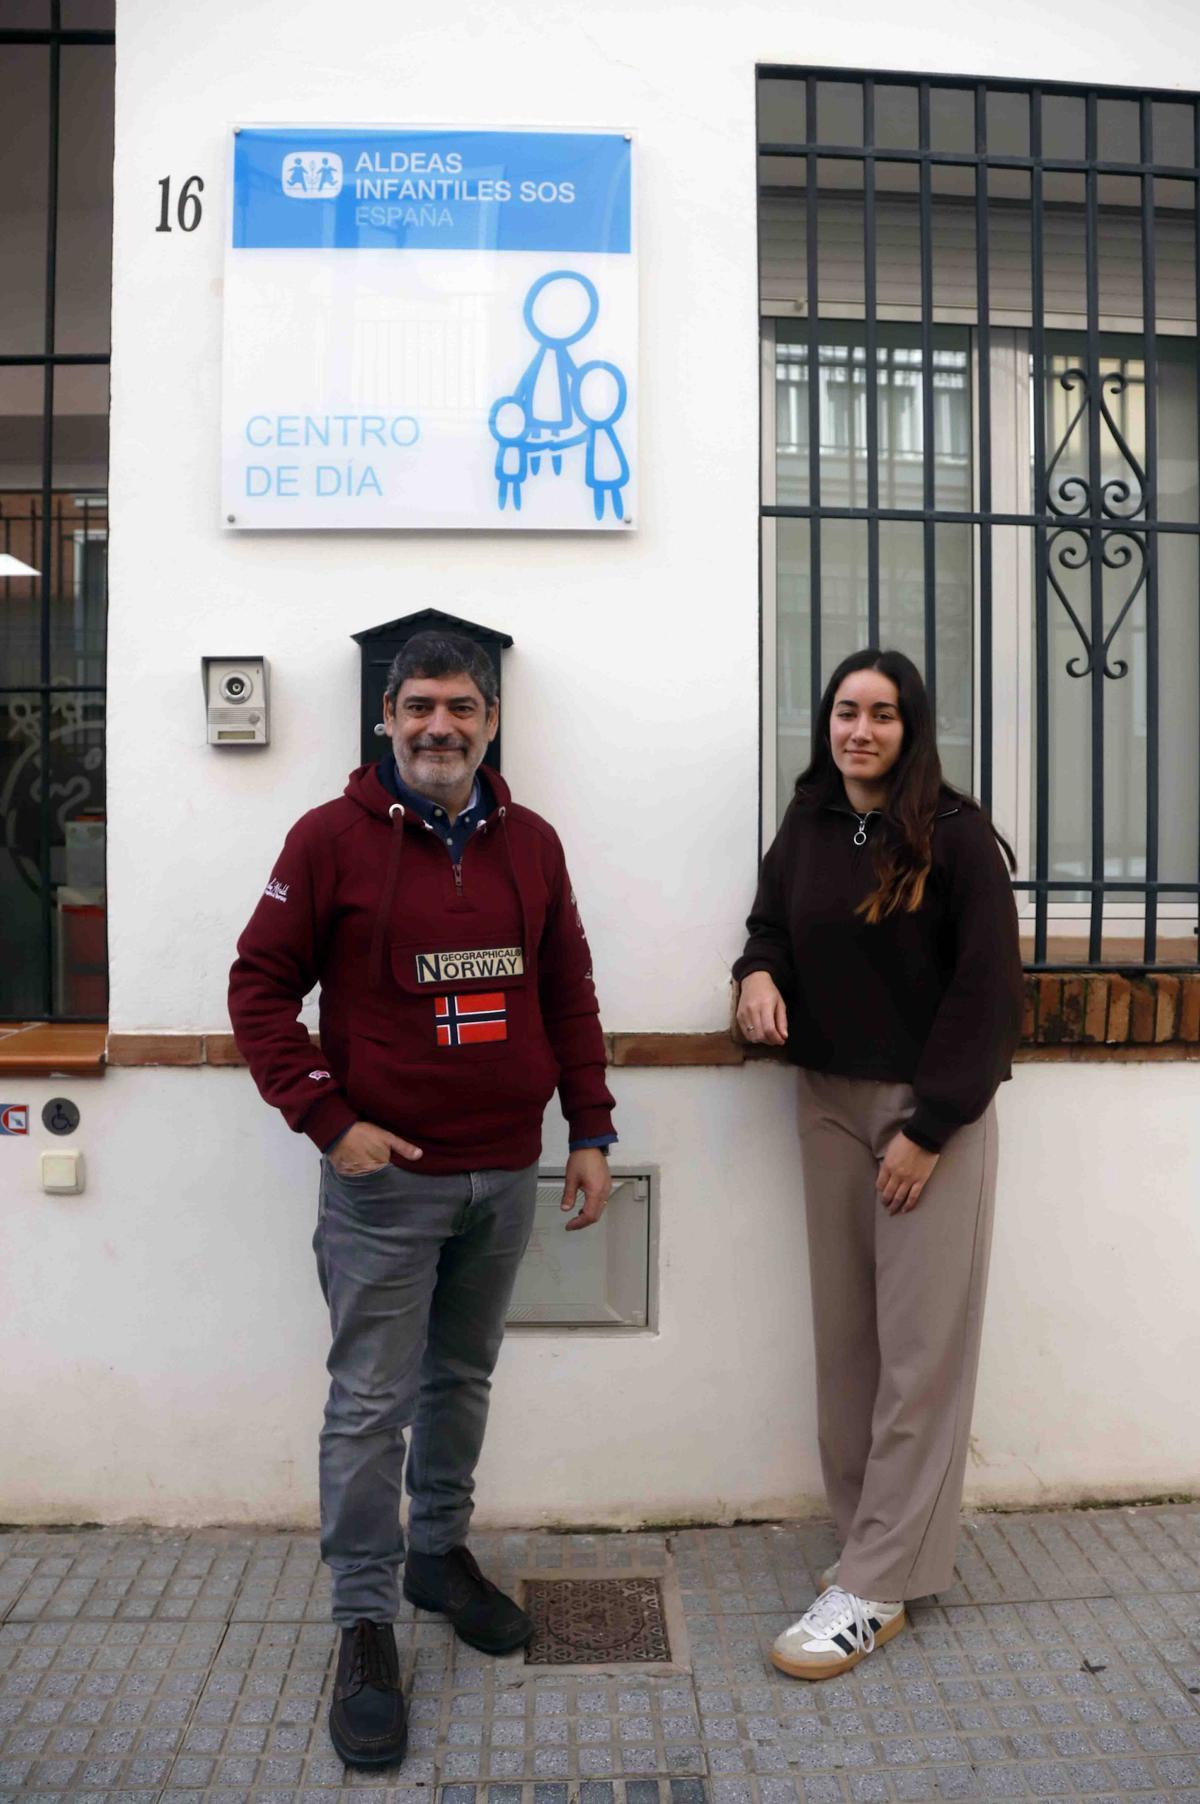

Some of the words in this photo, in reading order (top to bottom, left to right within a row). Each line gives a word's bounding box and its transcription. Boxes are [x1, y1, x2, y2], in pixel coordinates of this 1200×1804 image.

[355, 152, 463, 174] ALDEAS
[155, 174, 204, 232] 16
[355, 179, 512, 201] INFANTILES
[519, 181, 576, 204] SOS
[355, 203, 454, 227] ESPAÑA
[246, 415, 420, 447] CENTRO
[246, 465, 300, 497] DE
[316, 457, 383, 497] DÍA
